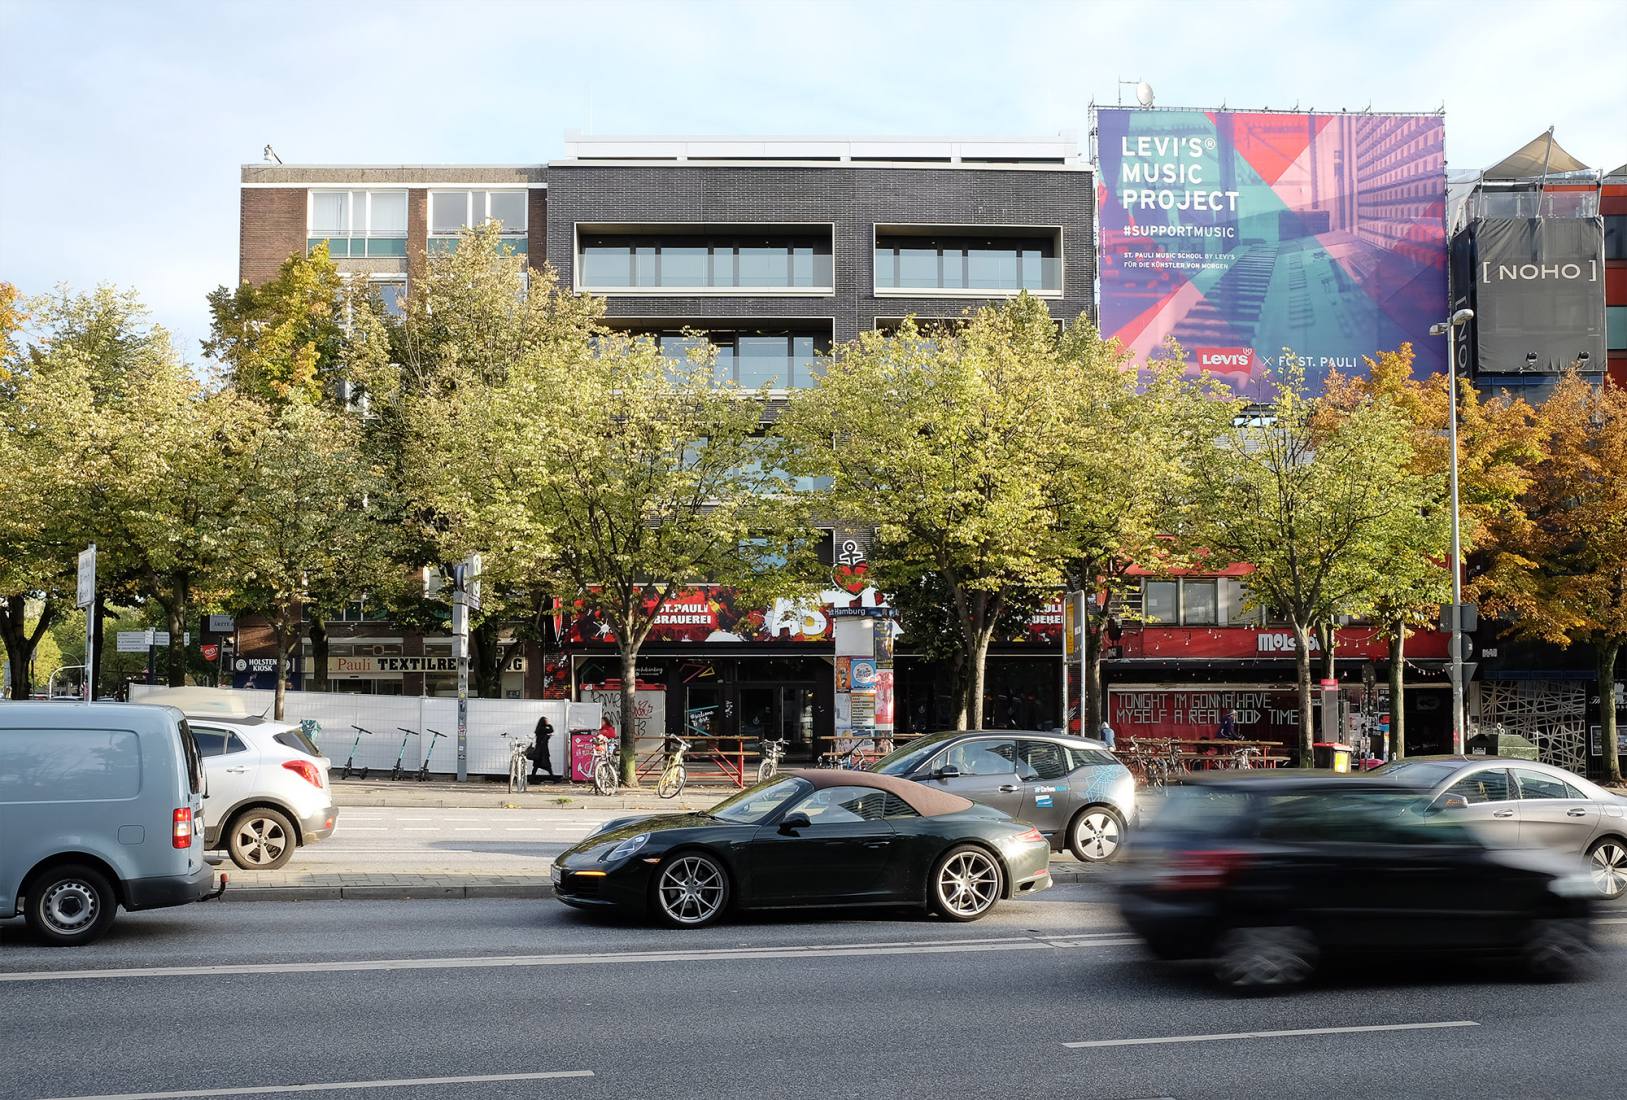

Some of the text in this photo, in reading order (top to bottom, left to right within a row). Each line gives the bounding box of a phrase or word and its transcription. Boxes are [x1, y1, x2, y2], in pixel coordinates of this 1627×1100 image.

[1122, 162, 1202, 184] MUSIC
[1122, 189, 1240, 211] PROJECT
[1123, 225, 1235, 238] #SUPPORTMUSIC
[1151, 261, 1185, 269] KÜNSTLER
[1201, 262, 1229, 270] MORGEN
[1499, 263, 1581, 280] NOHO
[1299, 356, 1316, 367] ST.
[1320, 356, 1357, 368] PAULI
[834, 608, 866, 616] Hamburg
[653, 615, 712, 624] BRAUEREI
[248, 658, 278, 666] HOLSTEN
[337, 658, 372, 671] Pauli
[1116, 693, 1272, 709] TONIGHT I'M GONNA HAVE
[1116, 709, 1299, 725] MYSELF A REAL OOD TIME
